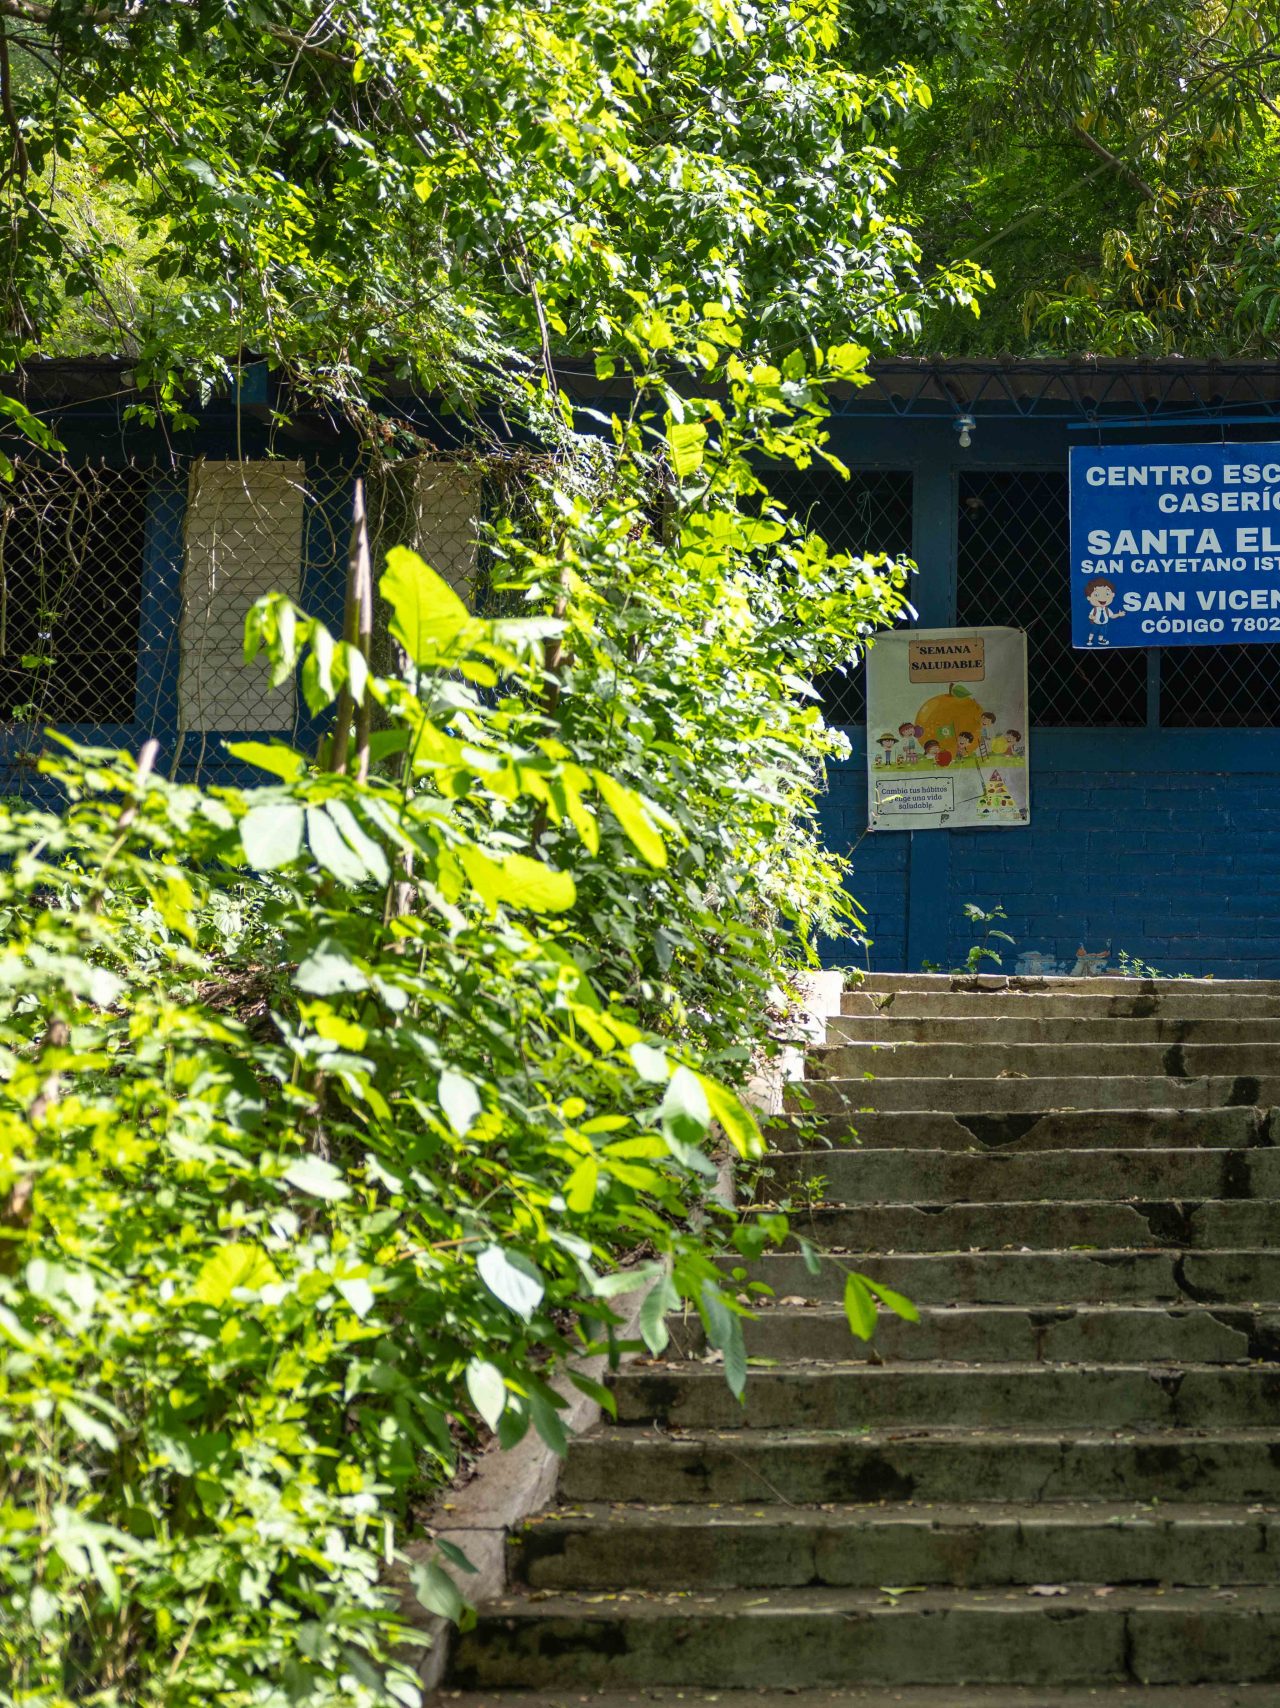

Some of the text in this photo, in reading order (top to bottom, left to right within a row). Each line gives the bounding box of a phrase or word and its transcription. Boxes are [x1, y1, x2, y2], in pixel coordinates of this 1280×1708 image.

[1085, 465, 1213, 487] CENTRO
[1087, 528, 1223, 556] SANTA
[1080, 559, 1124, 574] SAN
[1130, 557, 1247, 574] CAYETANO
[1122, 591, 1186, 612] SAN
[1141, 616, 1225, 634] CÓDIGO
[919, 645, 971, 655] SEMANA
[911, 659, 983, 671] SALUDABLE
